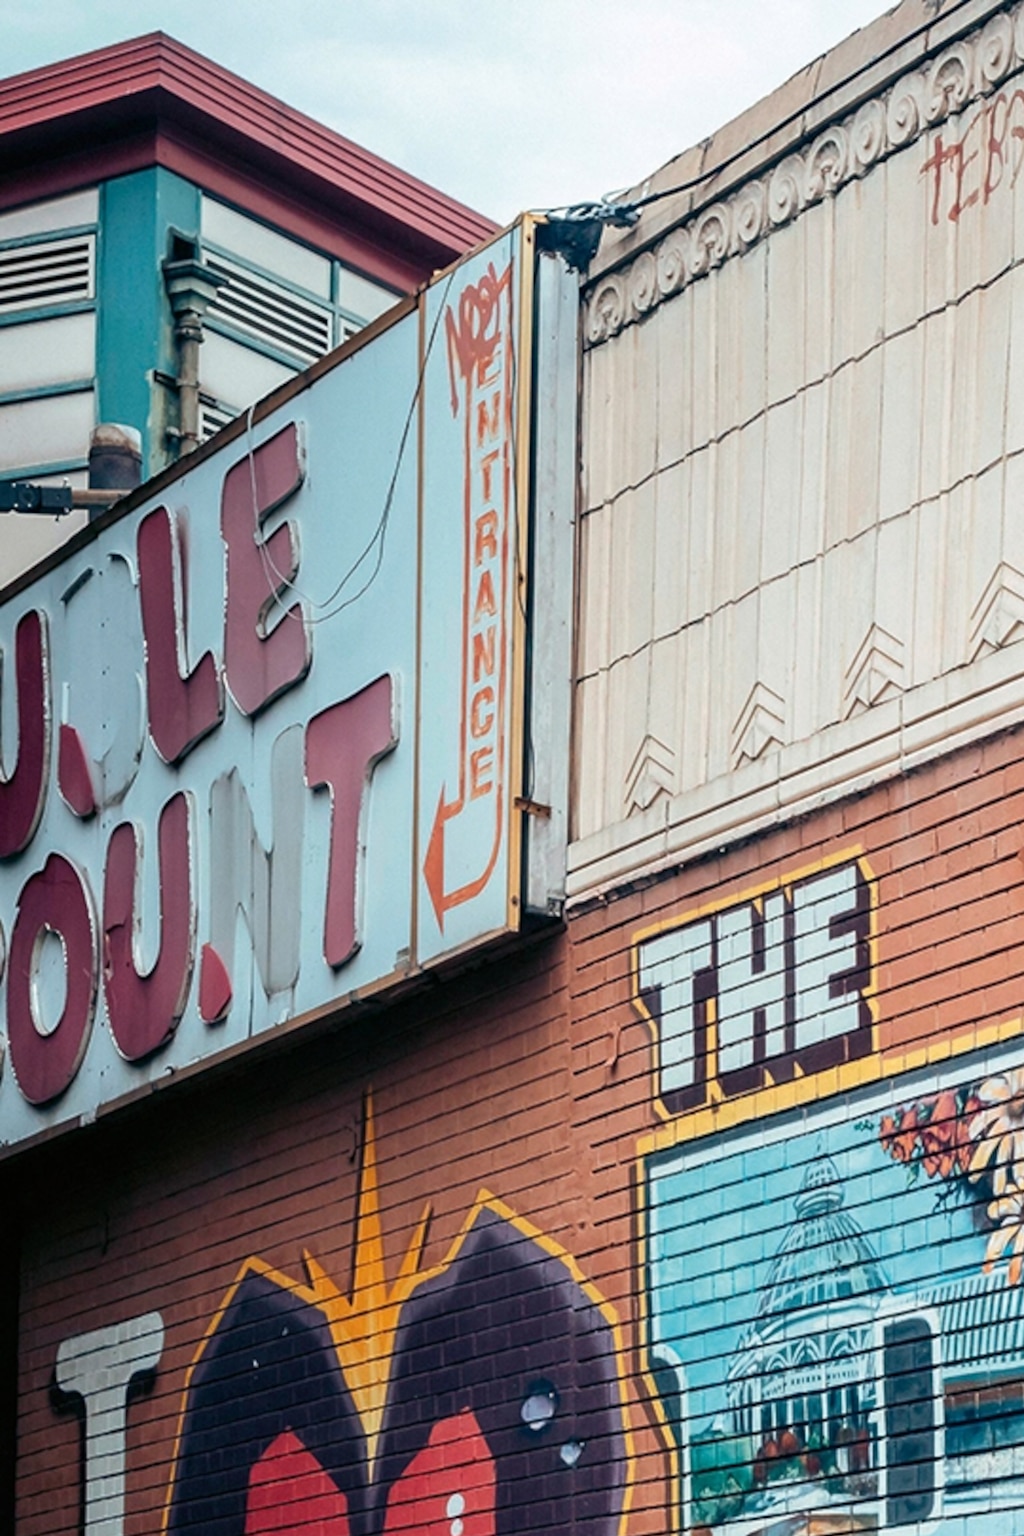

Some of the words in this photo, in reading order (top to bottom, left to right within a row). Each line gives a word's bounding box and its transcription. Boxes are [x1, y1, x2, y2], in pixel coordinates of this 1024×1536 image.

[0, 419, 313, 860] ULE
[469, 350, 502, 798] ENTRANCE
[0, 672, 401, 1107] OUNT
[639, 864, 861, 1093] THE
